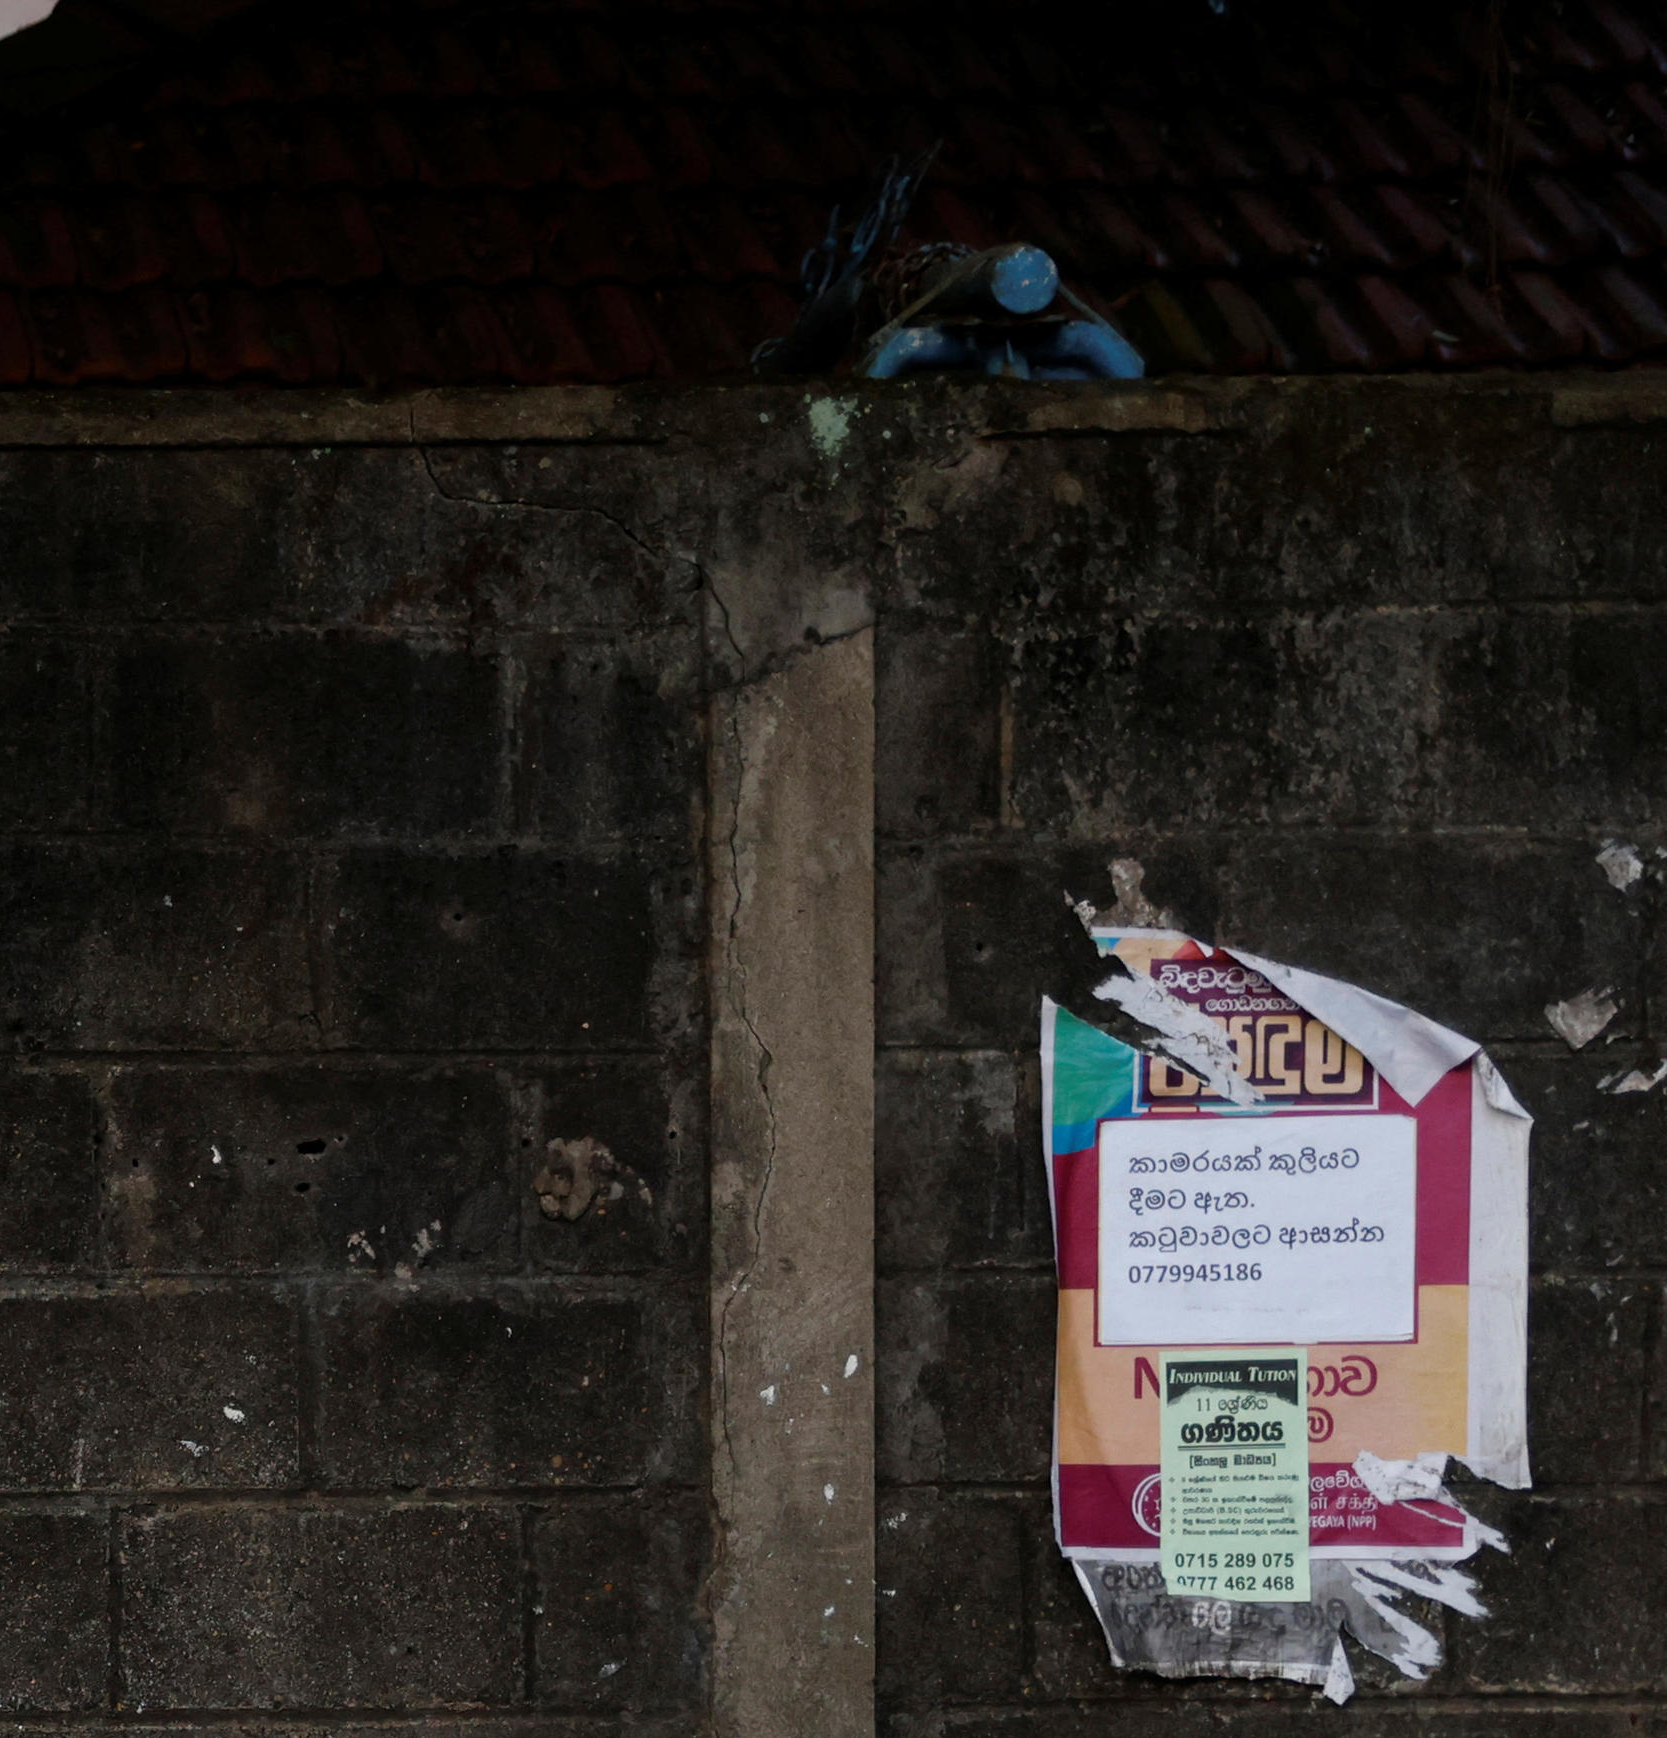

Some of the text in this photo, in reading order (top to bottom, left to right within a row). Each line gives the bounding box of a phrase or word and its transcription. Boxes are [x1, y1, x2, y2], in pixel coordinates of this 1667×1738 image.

[1128, 1145, 1360, 1176] කාමරයක් කුලියට
[1128, 1187, 1255, 1216] දීමට ඇත.
[1128, 1217, 1385, 1253] කටුවාවලට ආසන්න
[1128, 1263, 1263, 1284] 0779945186
[1169, 1366, 1297, 1385] INDIVIDUAL TUTION
[1196, 1398, 1211, 1412] 11
[1180, 1414, 1284, 1444] ගණිතය
[1309, 1515, 1345, 1528] EGAYA
[1347, 1514, 1377, 1530] (NPP)
[1174, 1551, 1295, 1569] 0715 289 075
[1224, 1575, 1257, 1591] 462
[1262, 1574, 1295, 1591] 468
